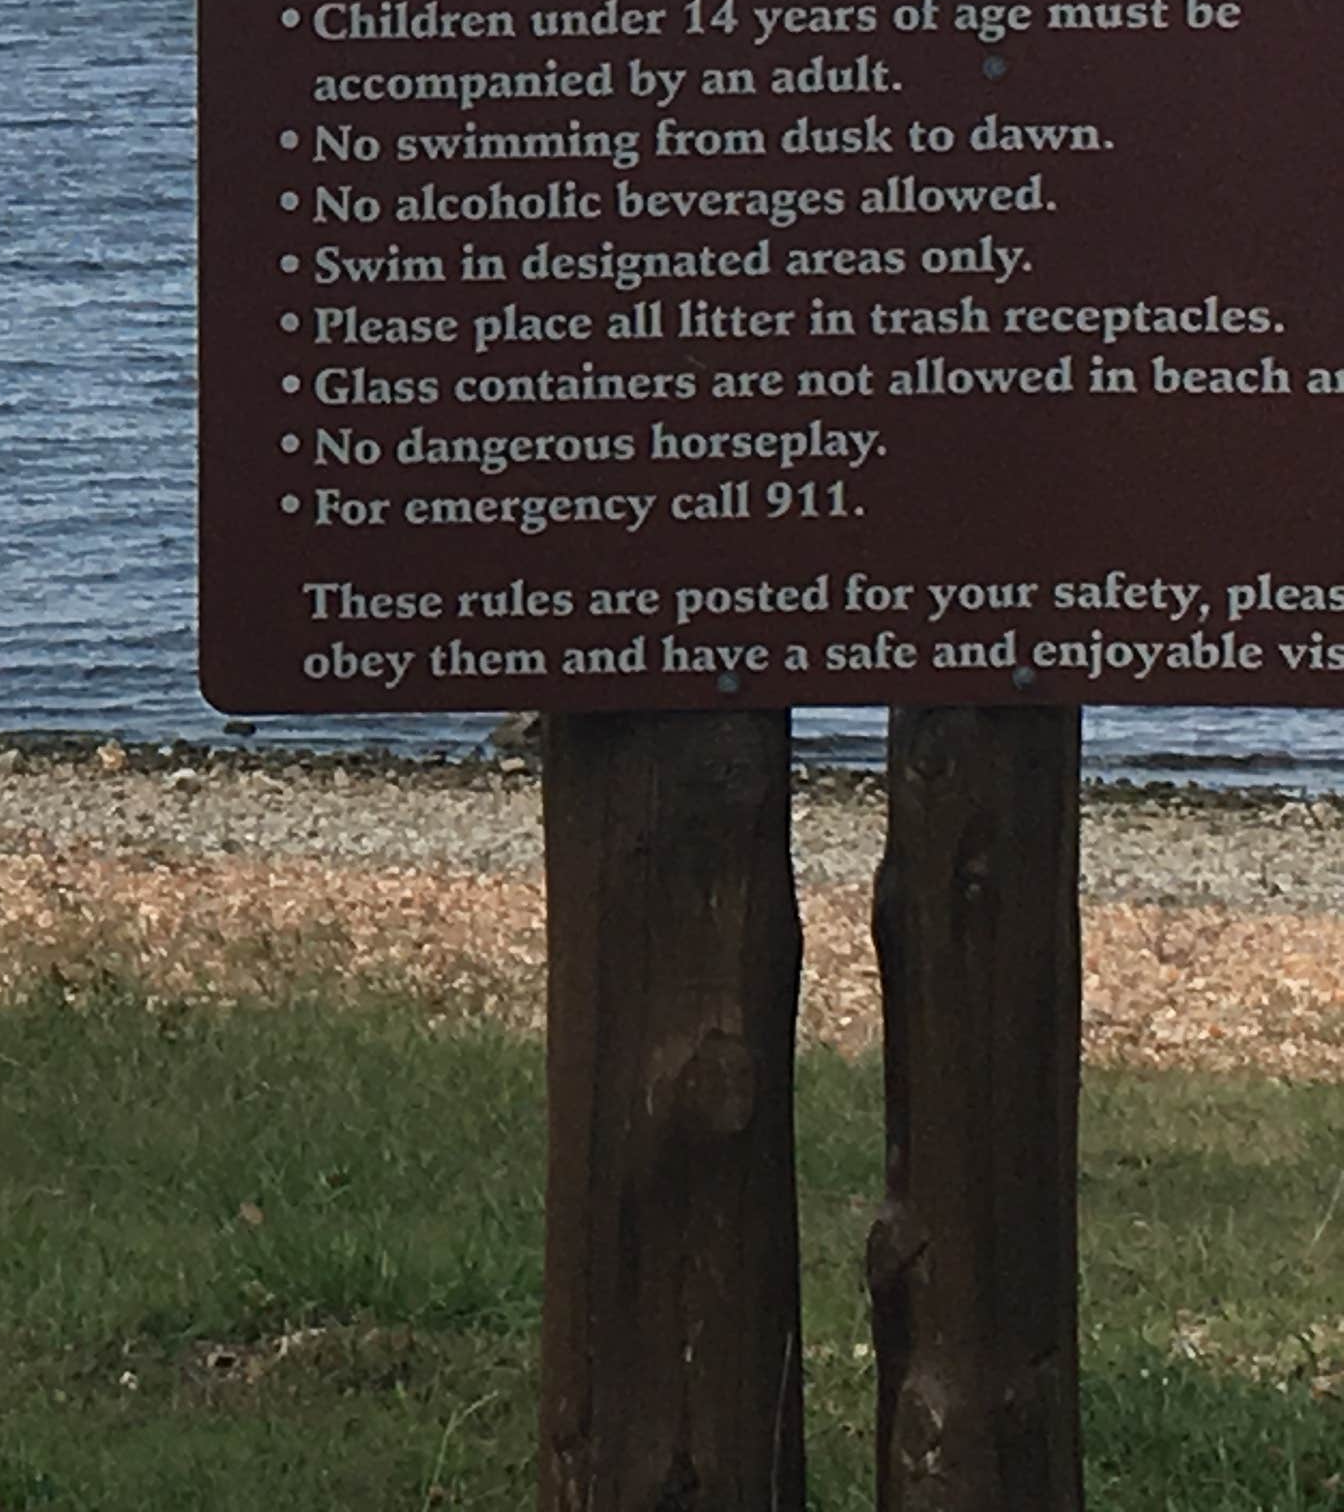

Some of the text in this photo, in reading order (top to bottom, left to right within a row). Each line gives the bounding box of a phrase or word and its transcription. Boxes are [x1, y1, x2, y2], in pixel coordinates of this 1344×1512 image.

[314, 0, 516, 40] Children
[754, 5, 877, 45] years
[954, 4, 1032, 42] age
[314, 54, 902, 110] accompanied by an adult.
[312, 113, 1114, 170] No swimming from dusk to dawn.
[313, 173, 1057, 228] No alcoholic beverages allowed.
[315, 234, 1032, 290] Swim in designated areas only.
[314, 295, 1285, 353] Please place all litter in trash receptacles.
[315, 367, 438, 404] Glass
[455, 361, 696, 402] containers
[712, 371, 783, 398] are
[797, 364, 874, 396] not
[889, 355, 1074, 395] allowed
[1089, 355, 1138, 393] in
[1151, 355, 1291, 394] beach
[315, 419, 887, 475] No dangerous horseplay.
[315, 480, 864, 534] For emergency call 911.
[303, 570, 1344, 625] These rules are posted for your safety, pleas
[304, 629, 1344, 688] obey them and have a safe and enjoyable vis
